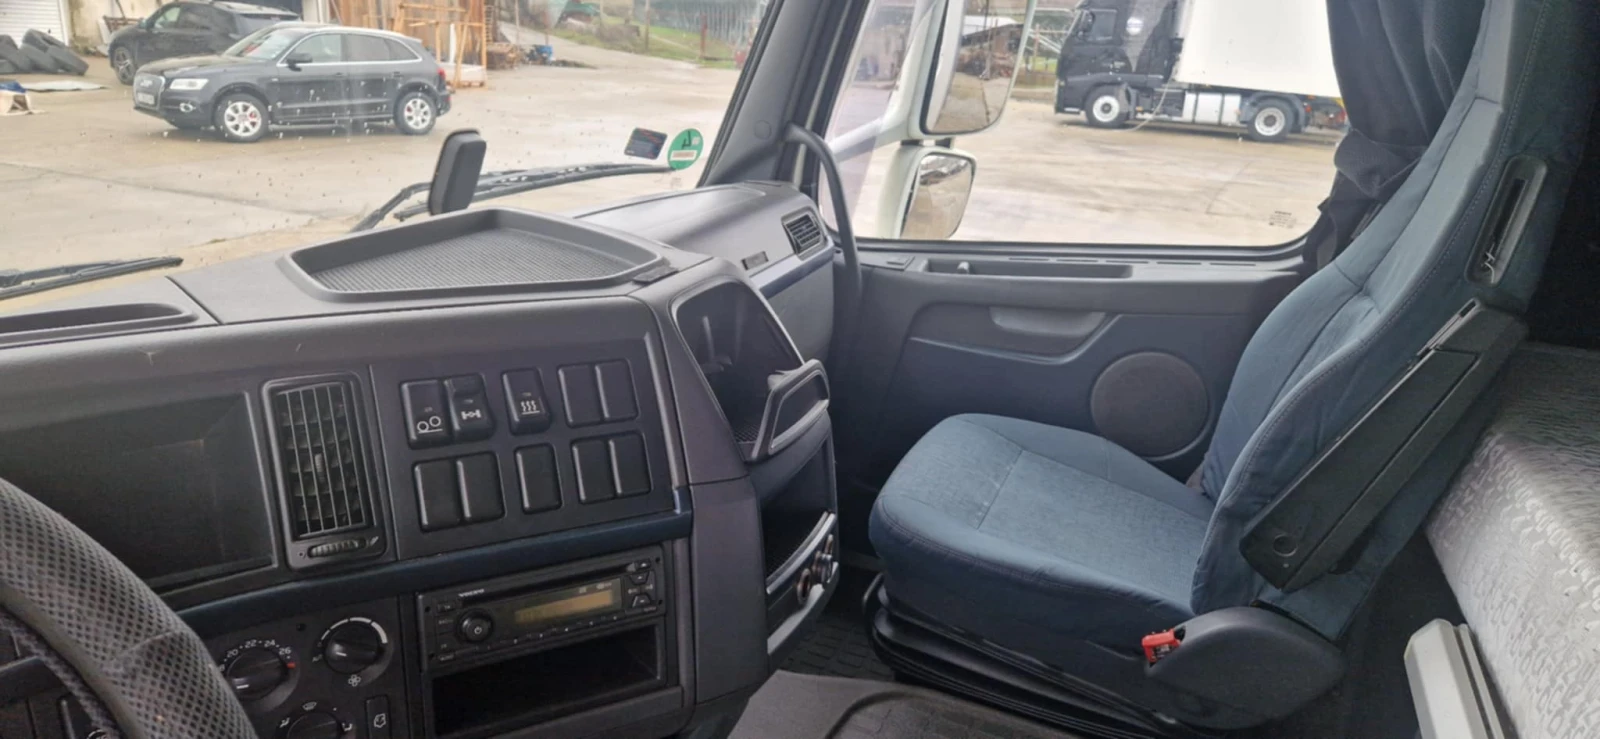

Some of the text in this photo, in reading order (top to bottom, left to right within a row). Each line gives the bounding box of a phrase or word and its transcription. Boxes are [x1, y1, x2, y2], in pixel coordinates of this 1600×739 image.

[244, 639, 257, 648] 22
[264, 639, 276, 648] 24
[227, 649, 238, 658] 20
[279, 646, 291, 655] 26
